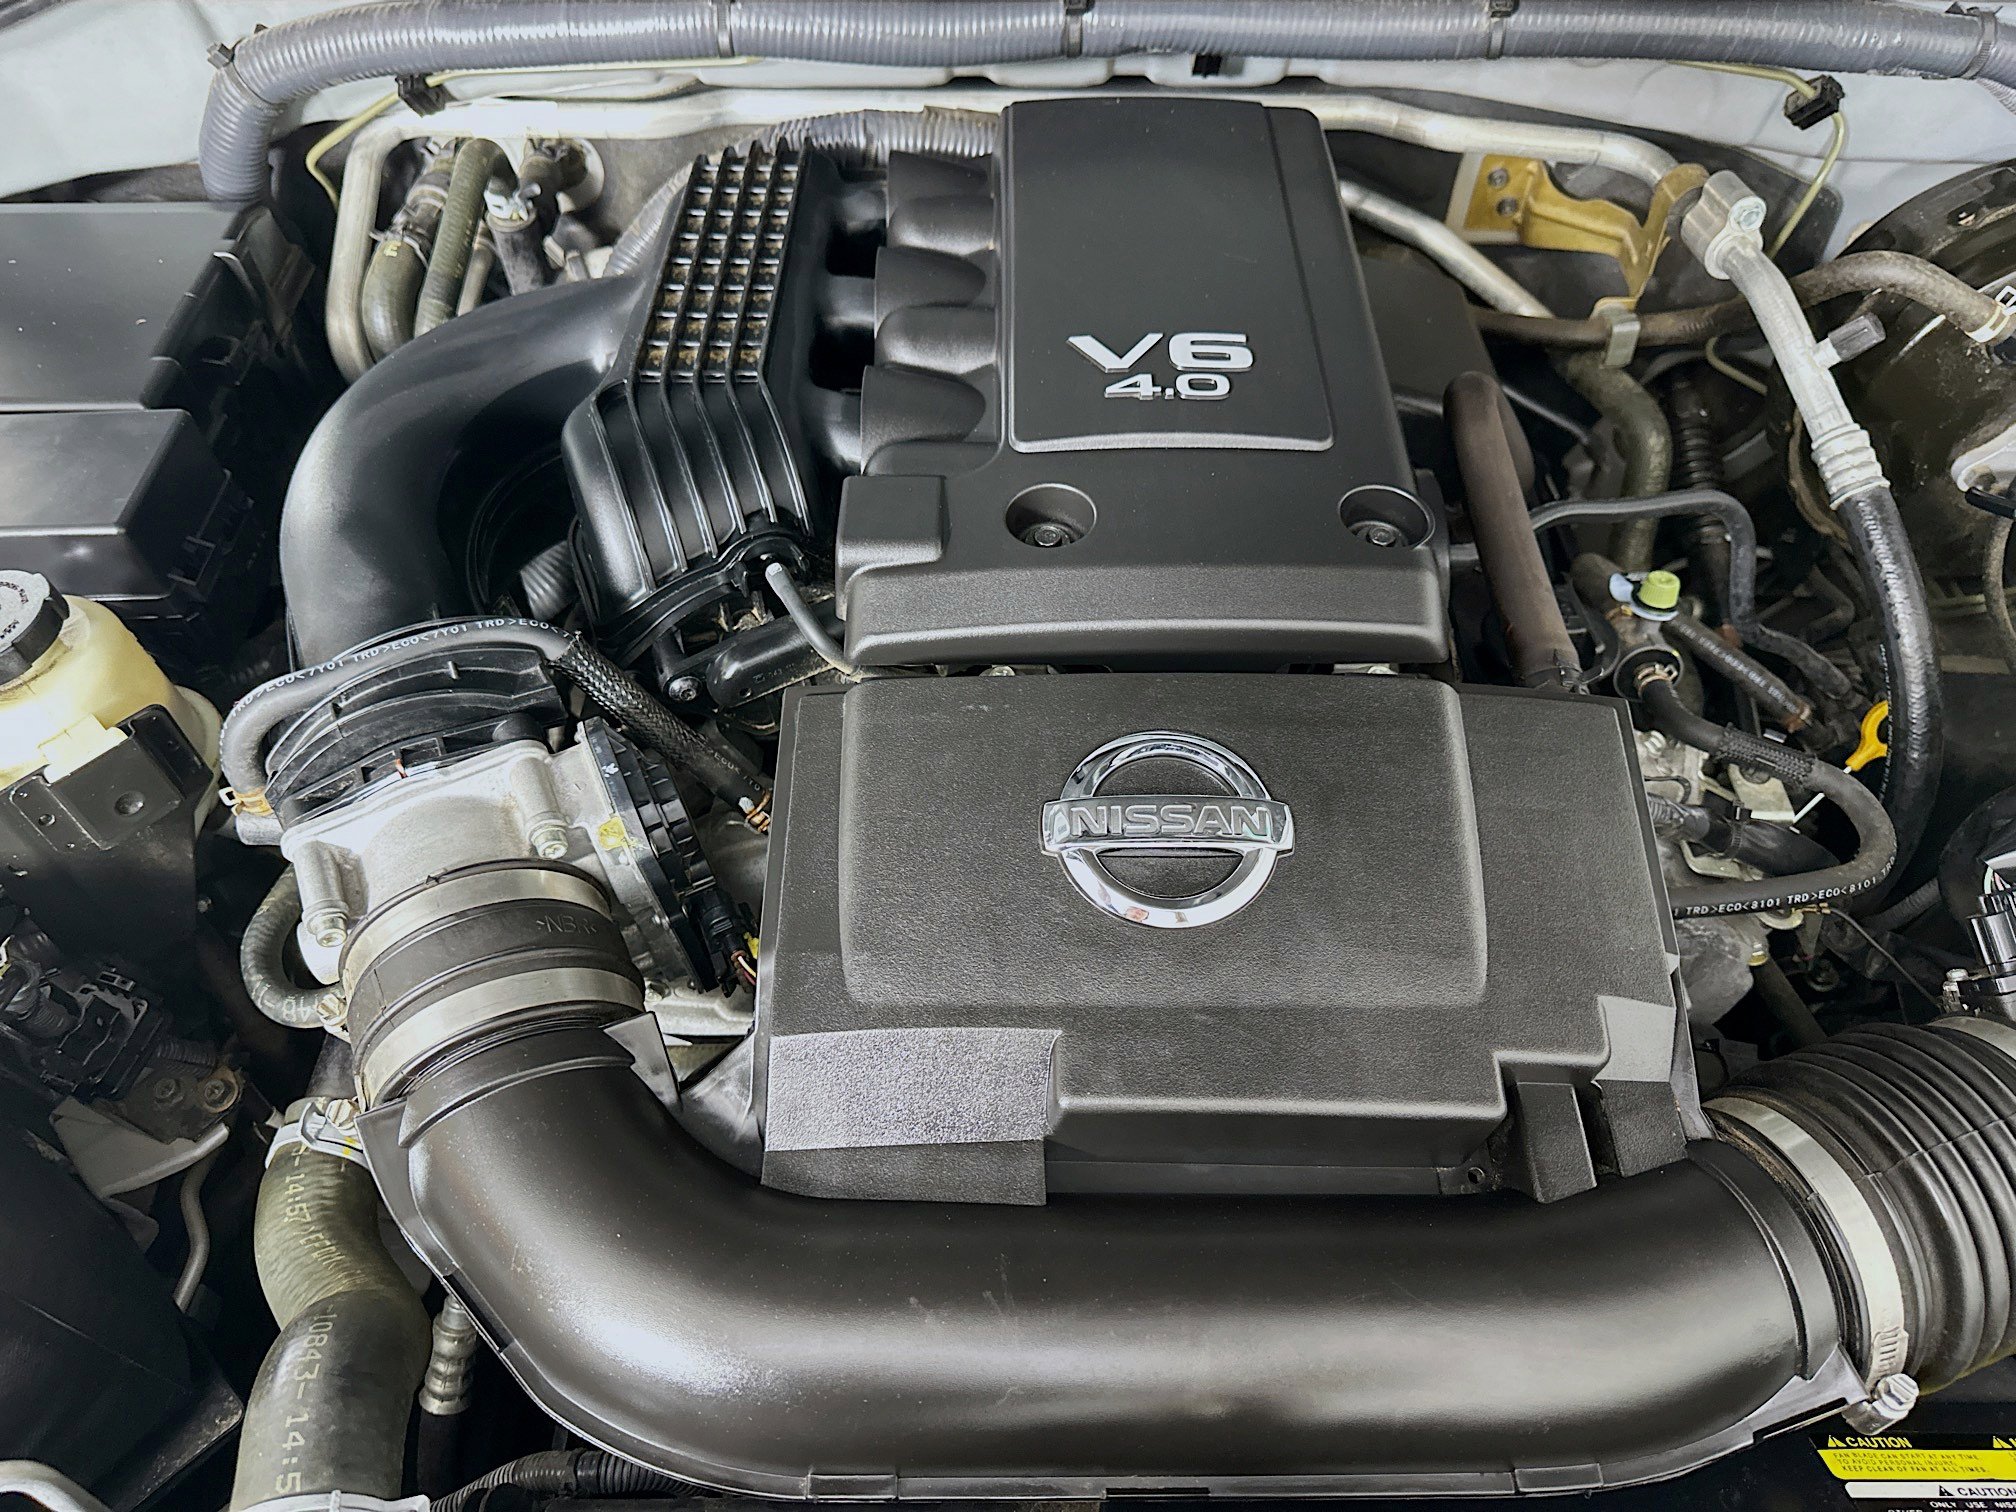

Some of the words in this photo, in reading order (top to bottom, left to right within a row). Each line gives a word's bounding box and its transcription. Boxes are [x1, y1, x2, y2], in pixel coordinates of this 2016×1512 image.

[1066, 332, 1254, 373] V6
[1104, 373, 1231, 400] 4.0
[1070, 803, 1269, 837] NISSAN
[1846, 1437, 1912, 1448] CAUTION
[1929, 1501, 1957, 1509] ONLY
[1965, 1501, 1988, 1509] USE
